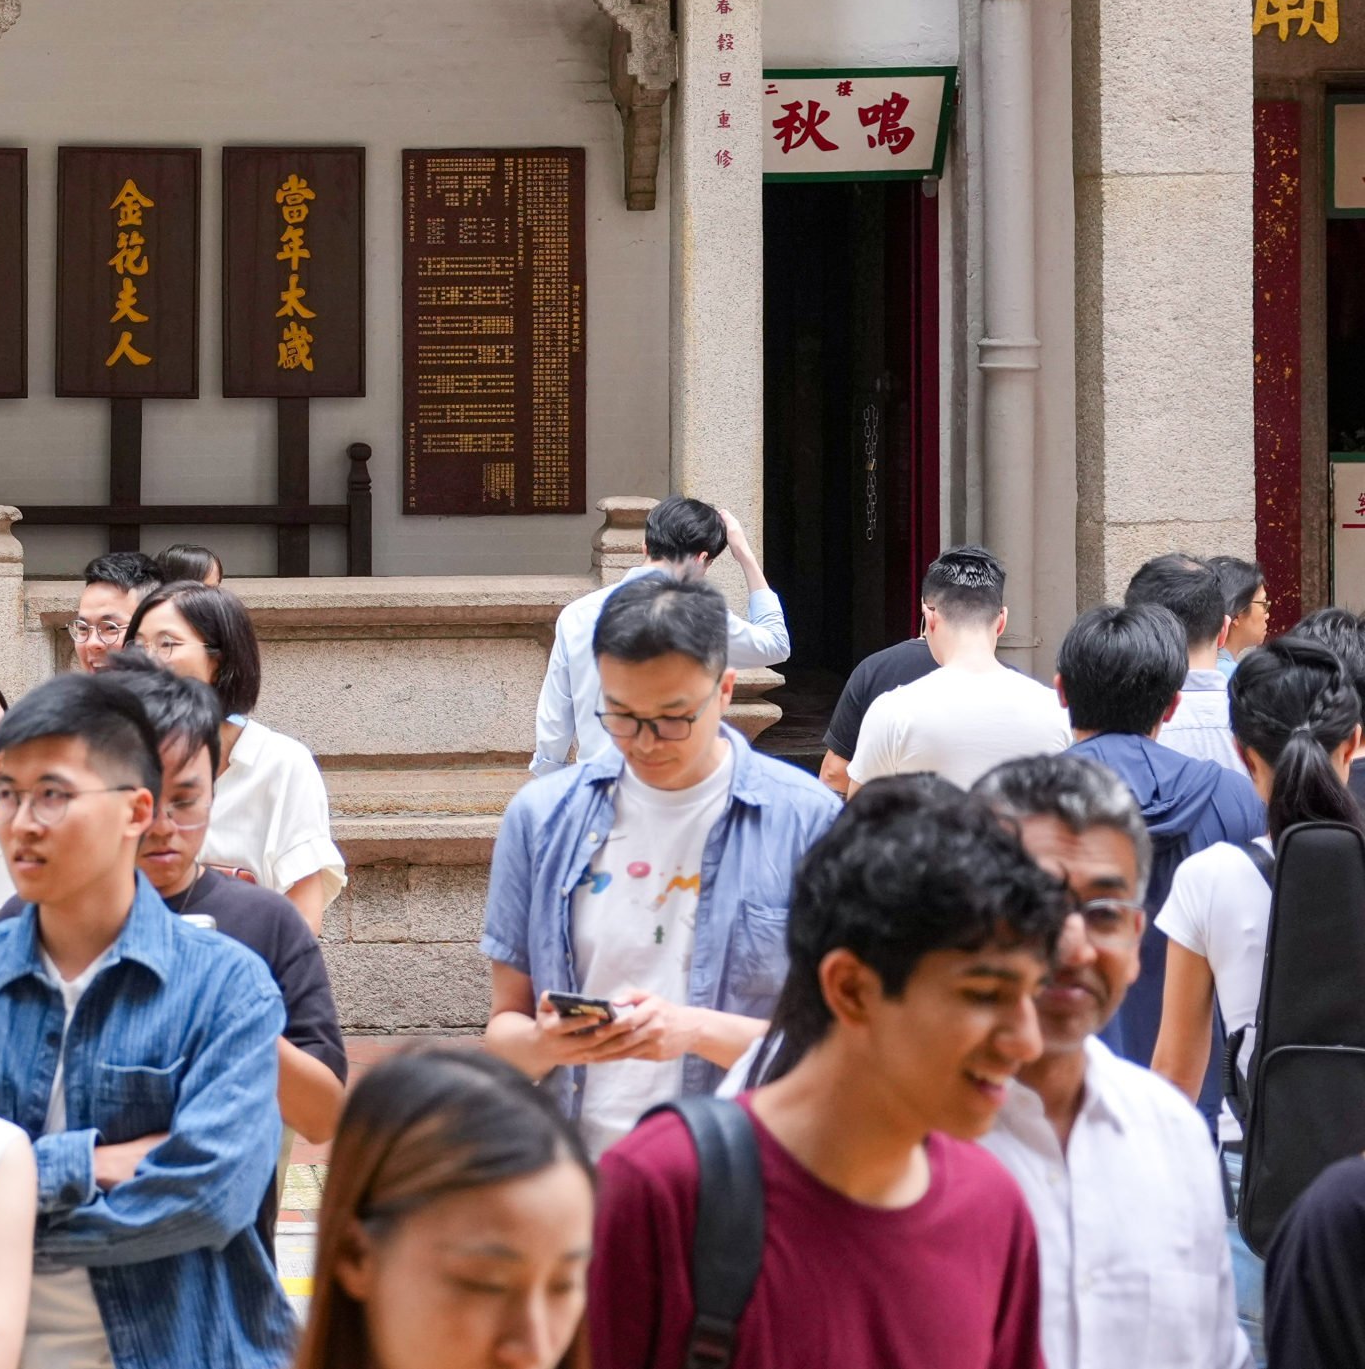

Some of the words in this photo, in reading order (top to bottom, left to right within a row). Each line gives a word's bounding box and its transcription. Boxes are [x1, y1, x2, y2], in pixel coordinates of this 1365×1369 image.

[105, 178, 155, 368] 金花夫人
[275, 173, 318, 373] 當年太歲
